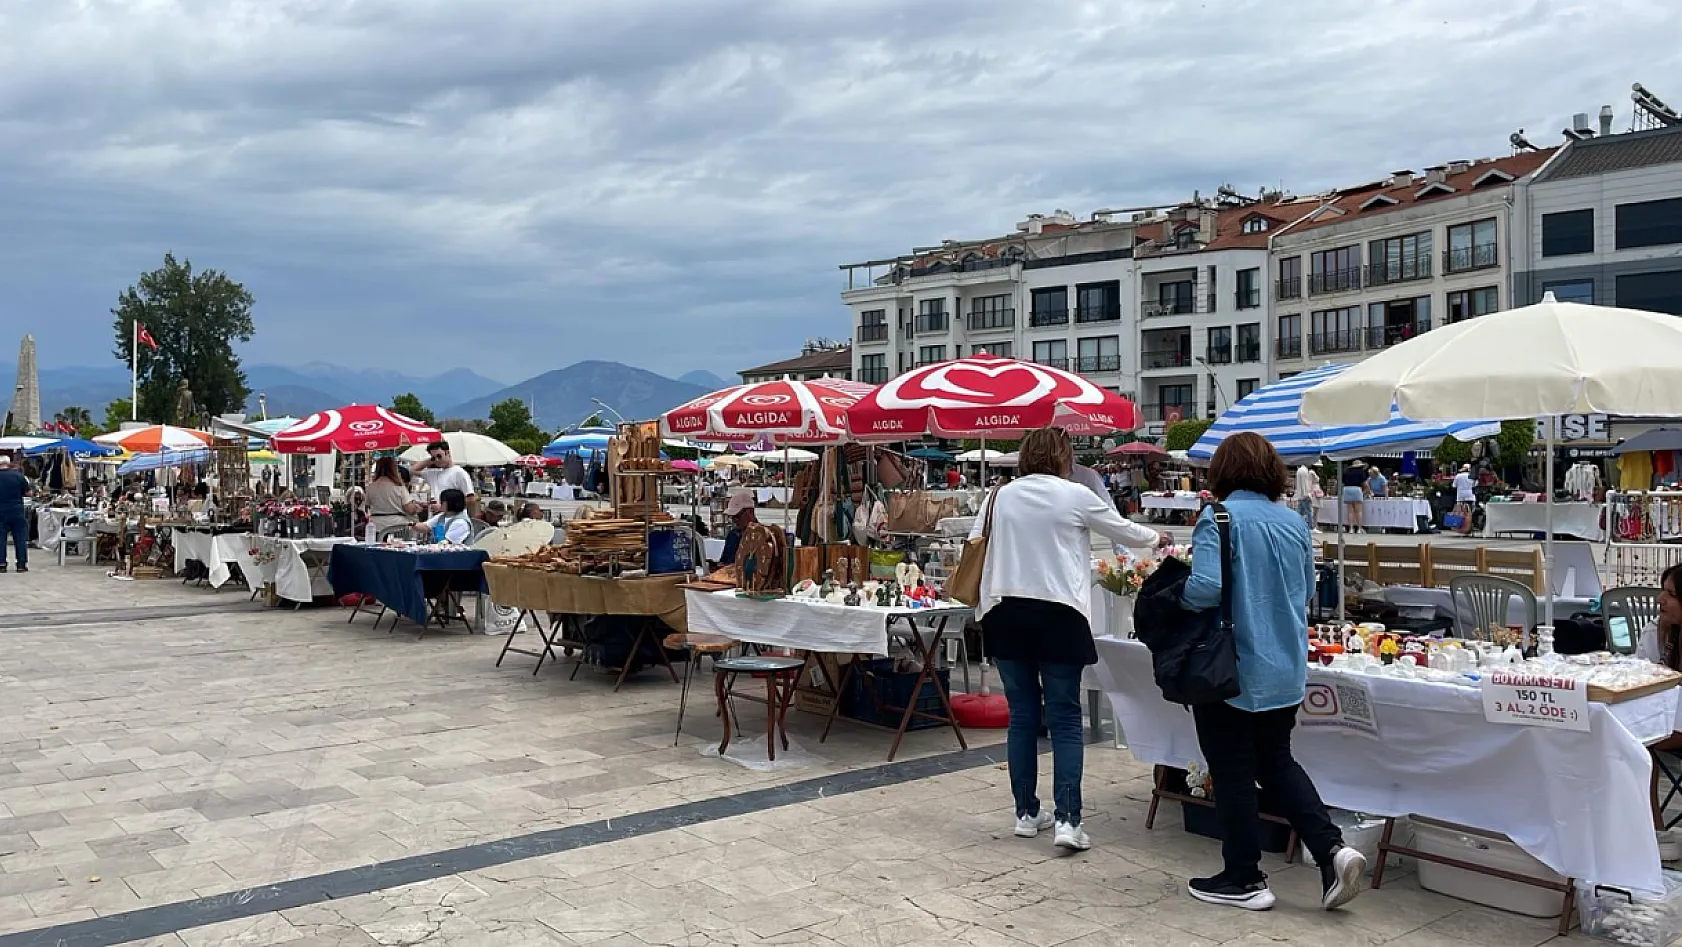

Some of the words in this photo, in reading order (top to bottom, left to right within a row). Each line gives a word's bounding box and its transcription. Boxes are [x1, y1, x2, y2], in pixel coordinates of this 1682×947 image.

[1515, 690, 1537, 701] 150
[1541, 692, 1555, 703] TL
[1495, 702, 1502, 712] 3
[1507, 703, 1526, 714] AL,
[1528, 704, 1536, 714] 2
[1539, 703, 1567, 718] ÖDE
